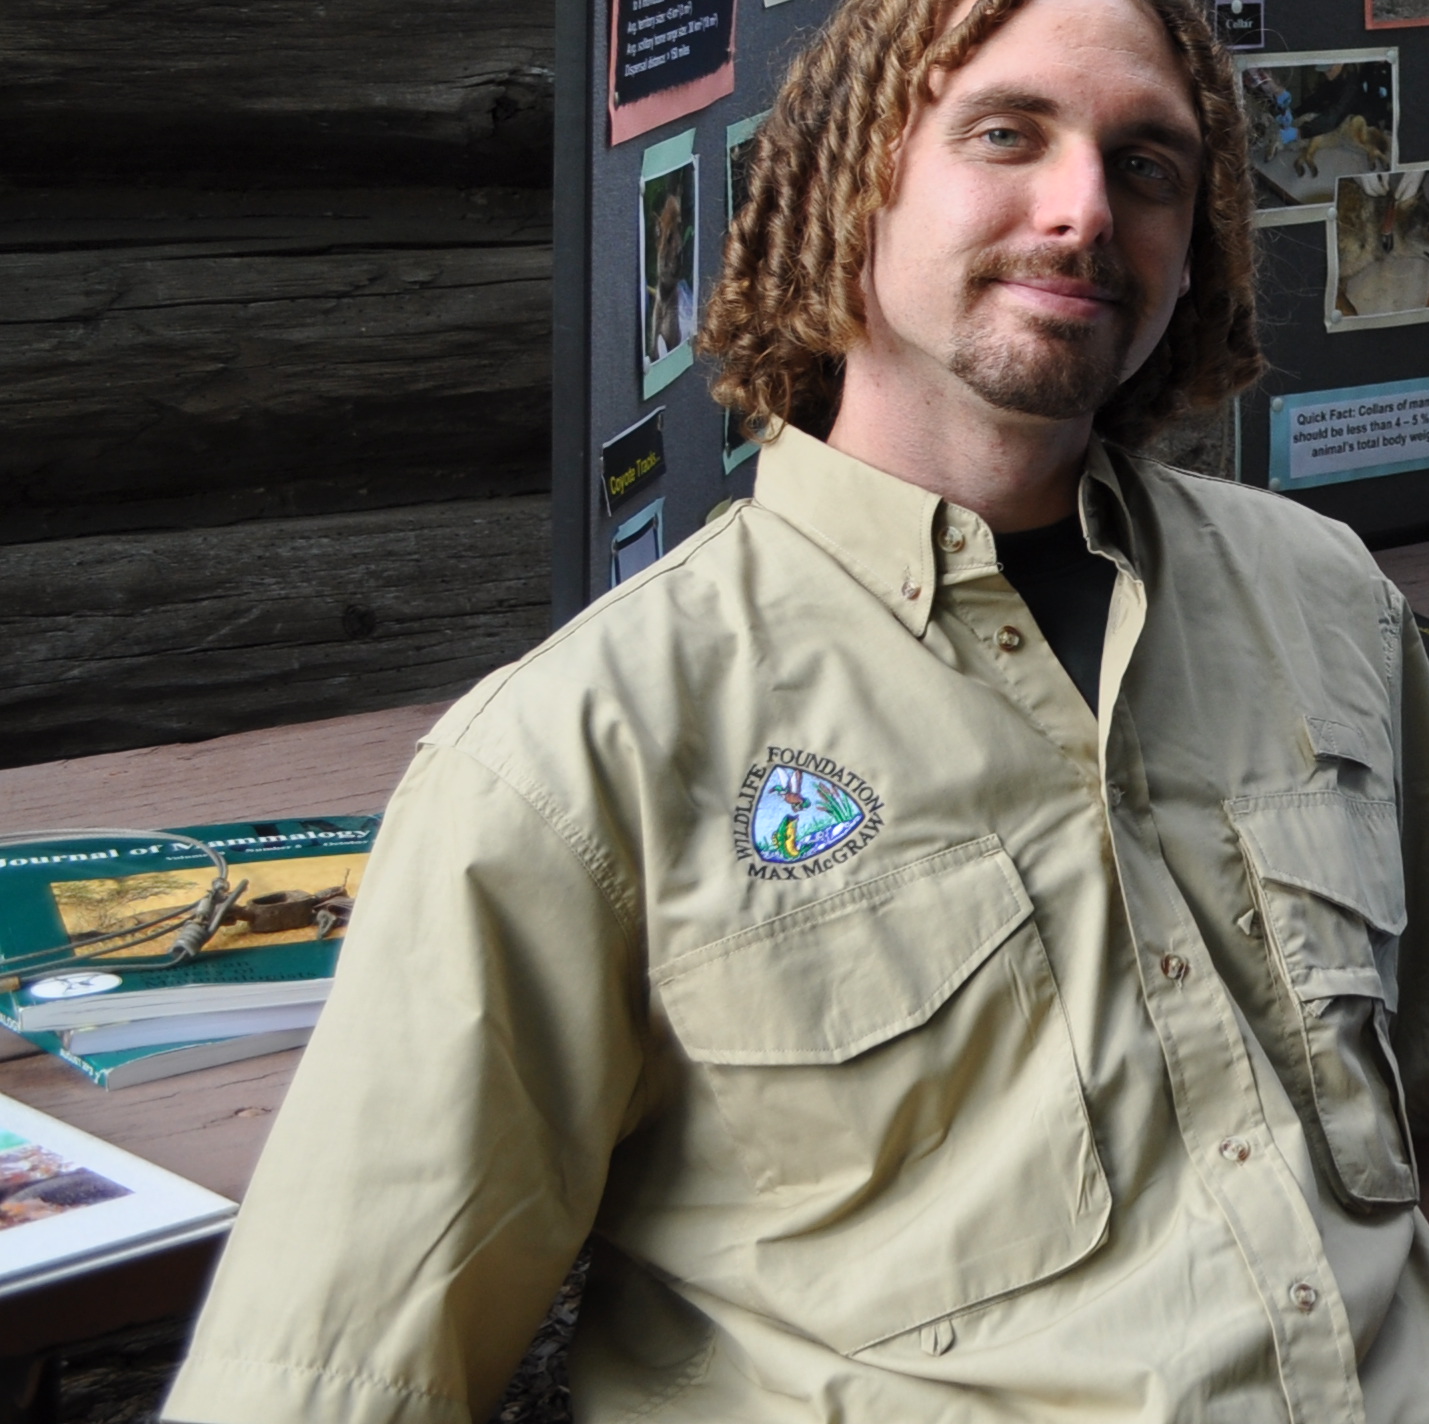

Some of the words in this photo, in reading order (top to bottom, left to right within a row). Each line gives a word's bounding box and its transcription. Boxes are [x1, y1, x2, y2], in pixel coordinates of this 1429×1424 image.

[1225, 18, 1253, 28] Collar
[1296, 411, 1327, 425] Quick
[1329, 408, 1355, 420] Fact:
[1358, 403, 1394, 416] Collars
[1396, 398, 1407, 411] of
[1292, 427, 1328, 443] should
[1330, 426, 1344, 438] be
[1346, 424, 1367, 435] less
[1369, 420, 1392, 431] than
[1394, 416, 1401, 428] 4
[1411, 414, 1418, 425] 5
[1311, 441, 1355, 457] animal's
[1356, 436, 1380, 450] total
[1382, 433, 1407, 446] body
[609, 468, 635, 494] Coyote
[733, 764, 766, 860] WILDLIFE
[767, 746, 885, 813] FOUNDATION
[0, 849, 119, 868] Journal
[130, 844, 163, 856] of
[172, 830, 371, 852] Mammalogy
[748, 863, 801, 880] MAX
[801, 812, 885, 878] McGRAW
